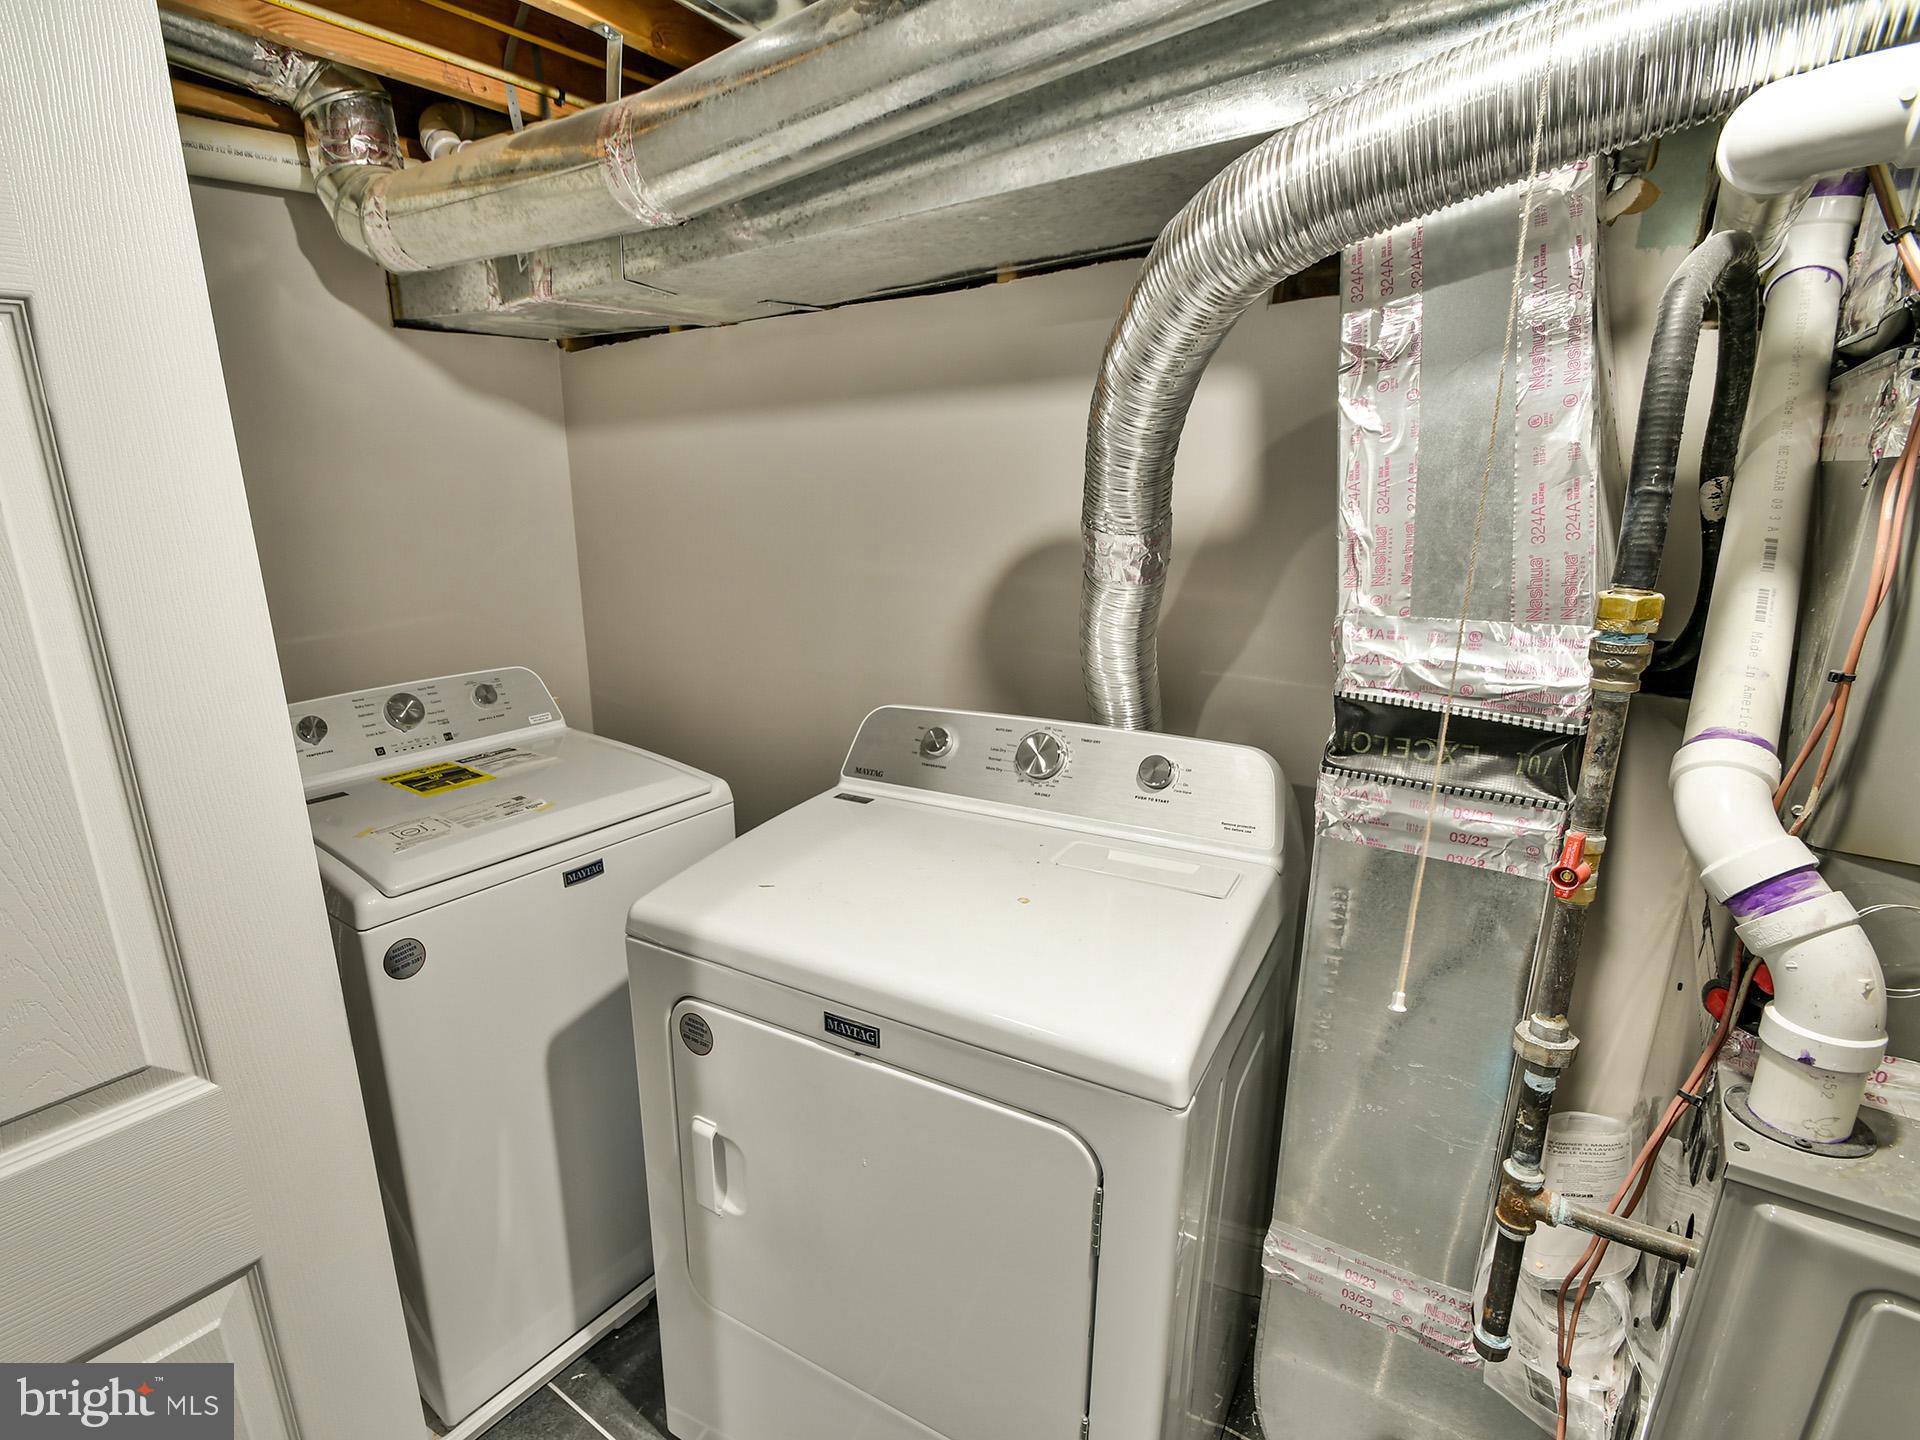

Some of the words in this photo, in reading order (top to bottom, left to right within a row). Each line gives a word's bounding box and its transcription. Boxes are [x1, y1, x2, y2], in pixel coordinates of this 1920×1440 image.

[1350, 264, 1364, 303] 324A
[1379, 256, 1394, 295] 324A
[1528, 319, 1546, 391] Nashua
[1563, 314, 1581, 384] Nashua
[1375, 477, 1390, 514] 324A
[1530, 504, 1546, 544] 324A
[1564, 500, 1581, 540] 324A
[1370, 525, 1386, 587] Nashua
[1525, 557, 1544, 622] Nashua
[1560, 553, 1579, 620] Nashua
[1750, 631, 1764, 658] Made
[1745, 665, 1760, 679] in
[1501, 687, 1577, 705] Nashua
[1738, 682, 1758, 735] America
[855, 767, 884, 778] MAYTAG
[1449, 831, 1490, 848] 03/23
[566, 861, 603, 886] MAYTAG
[826, 1018, 876, 1043] MAYTAG
[1344, 1268, 1377, 1290] 03/23
[1341, 1288, 1374, 1309] 03/23
